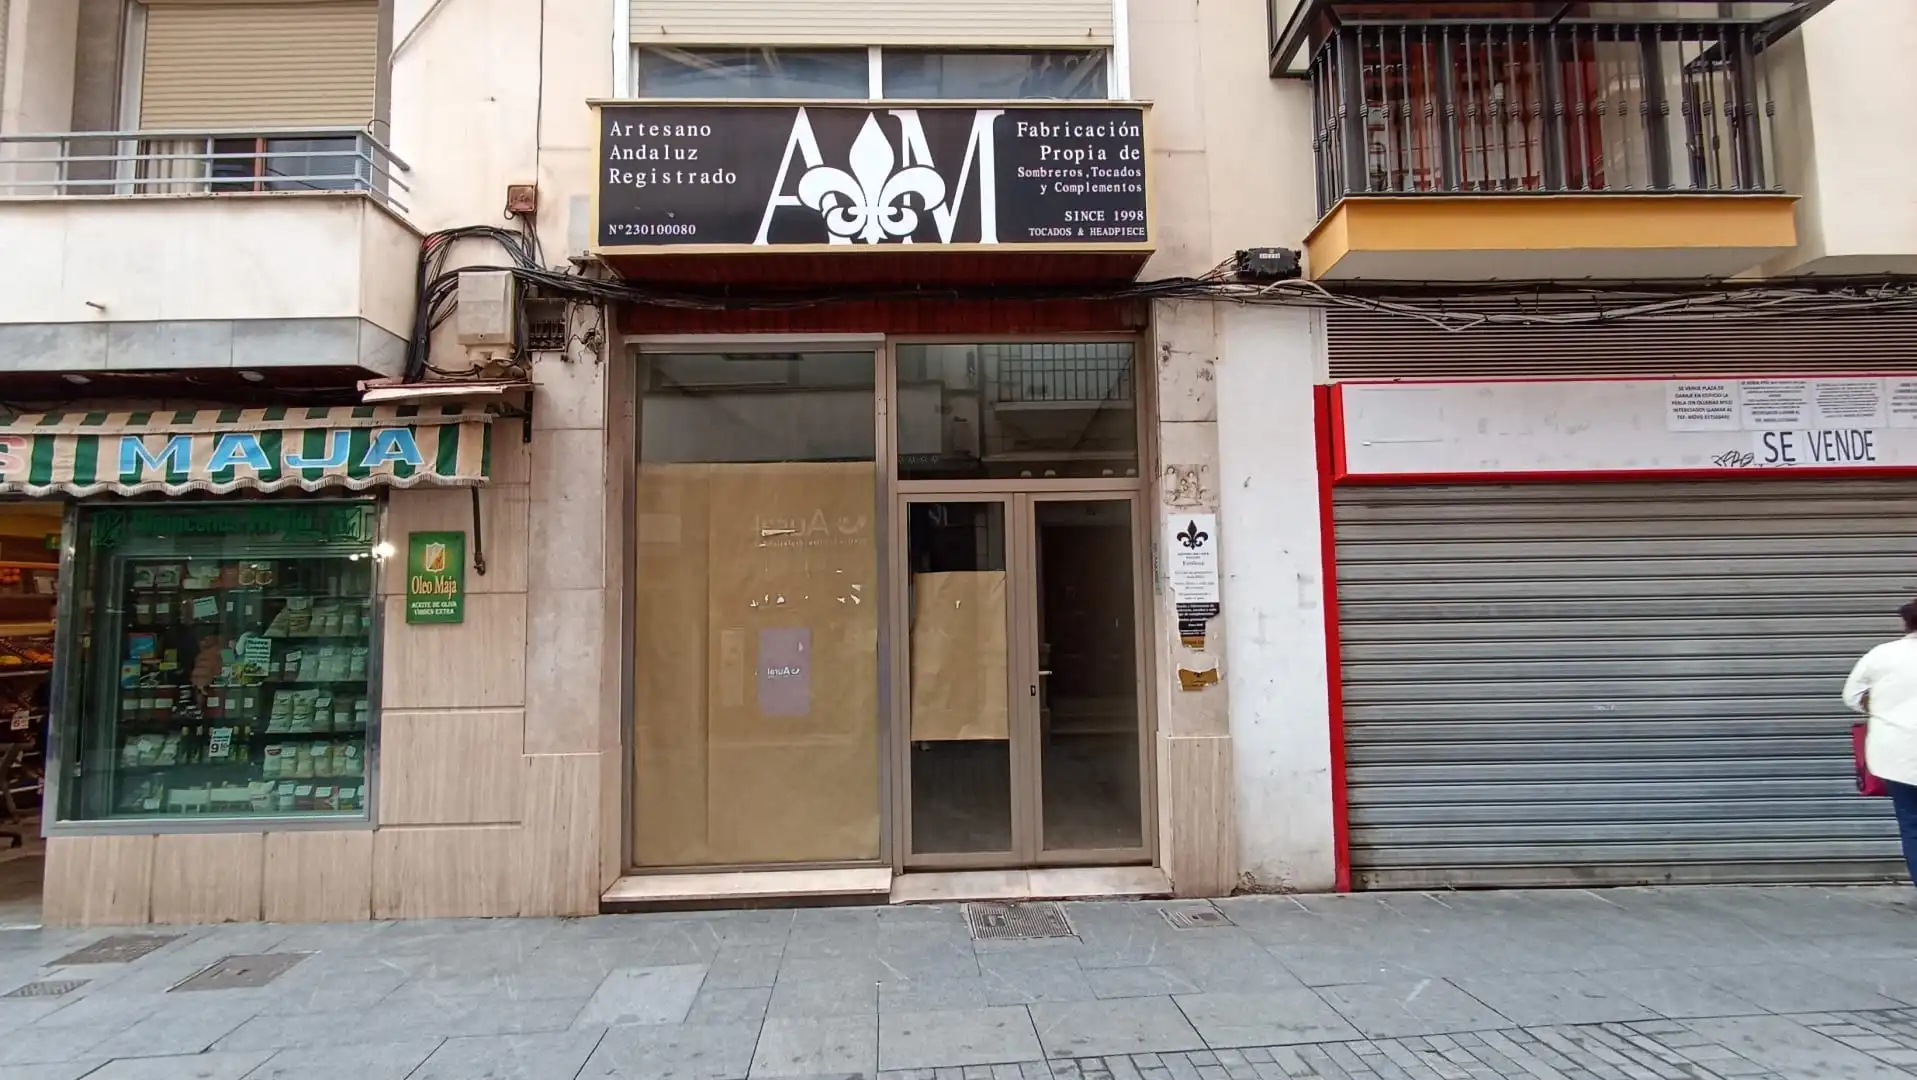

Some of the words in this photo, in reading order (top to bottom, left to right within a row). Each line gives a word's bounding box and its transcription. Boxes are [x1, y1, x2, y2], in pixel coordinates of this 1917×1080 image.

[610, 121, 712, 137] Artesano
[1016, 121, 1140, 138] Fabricación
[609, 144, 698, 160] Andaluz
[1040, 144, 1107, 165] Propia
[1119, 144, 1140, 160] de
[608, 168, 737, 188] Registrado
[1040, 184, 1047, 195] y
[1054, 182, 1142, 195] Complementos
[1064, 210, 1105, 221] SINCE
[1114, 210, 1144, 221] 1998
[1028, 227, 1072, 236] TOCADOS
[1077, 227, 1084, 236] &
[1090, 227, 1145, 236] HEADPIECE
[117, 428, 424, 475] MAJA
[1763, 432, 1796, 463] SE
[1807, 430, 1876, 462] VENDE
[411, 575, 432, 595] Oleo
[434, 575, 457, 600] Maja
